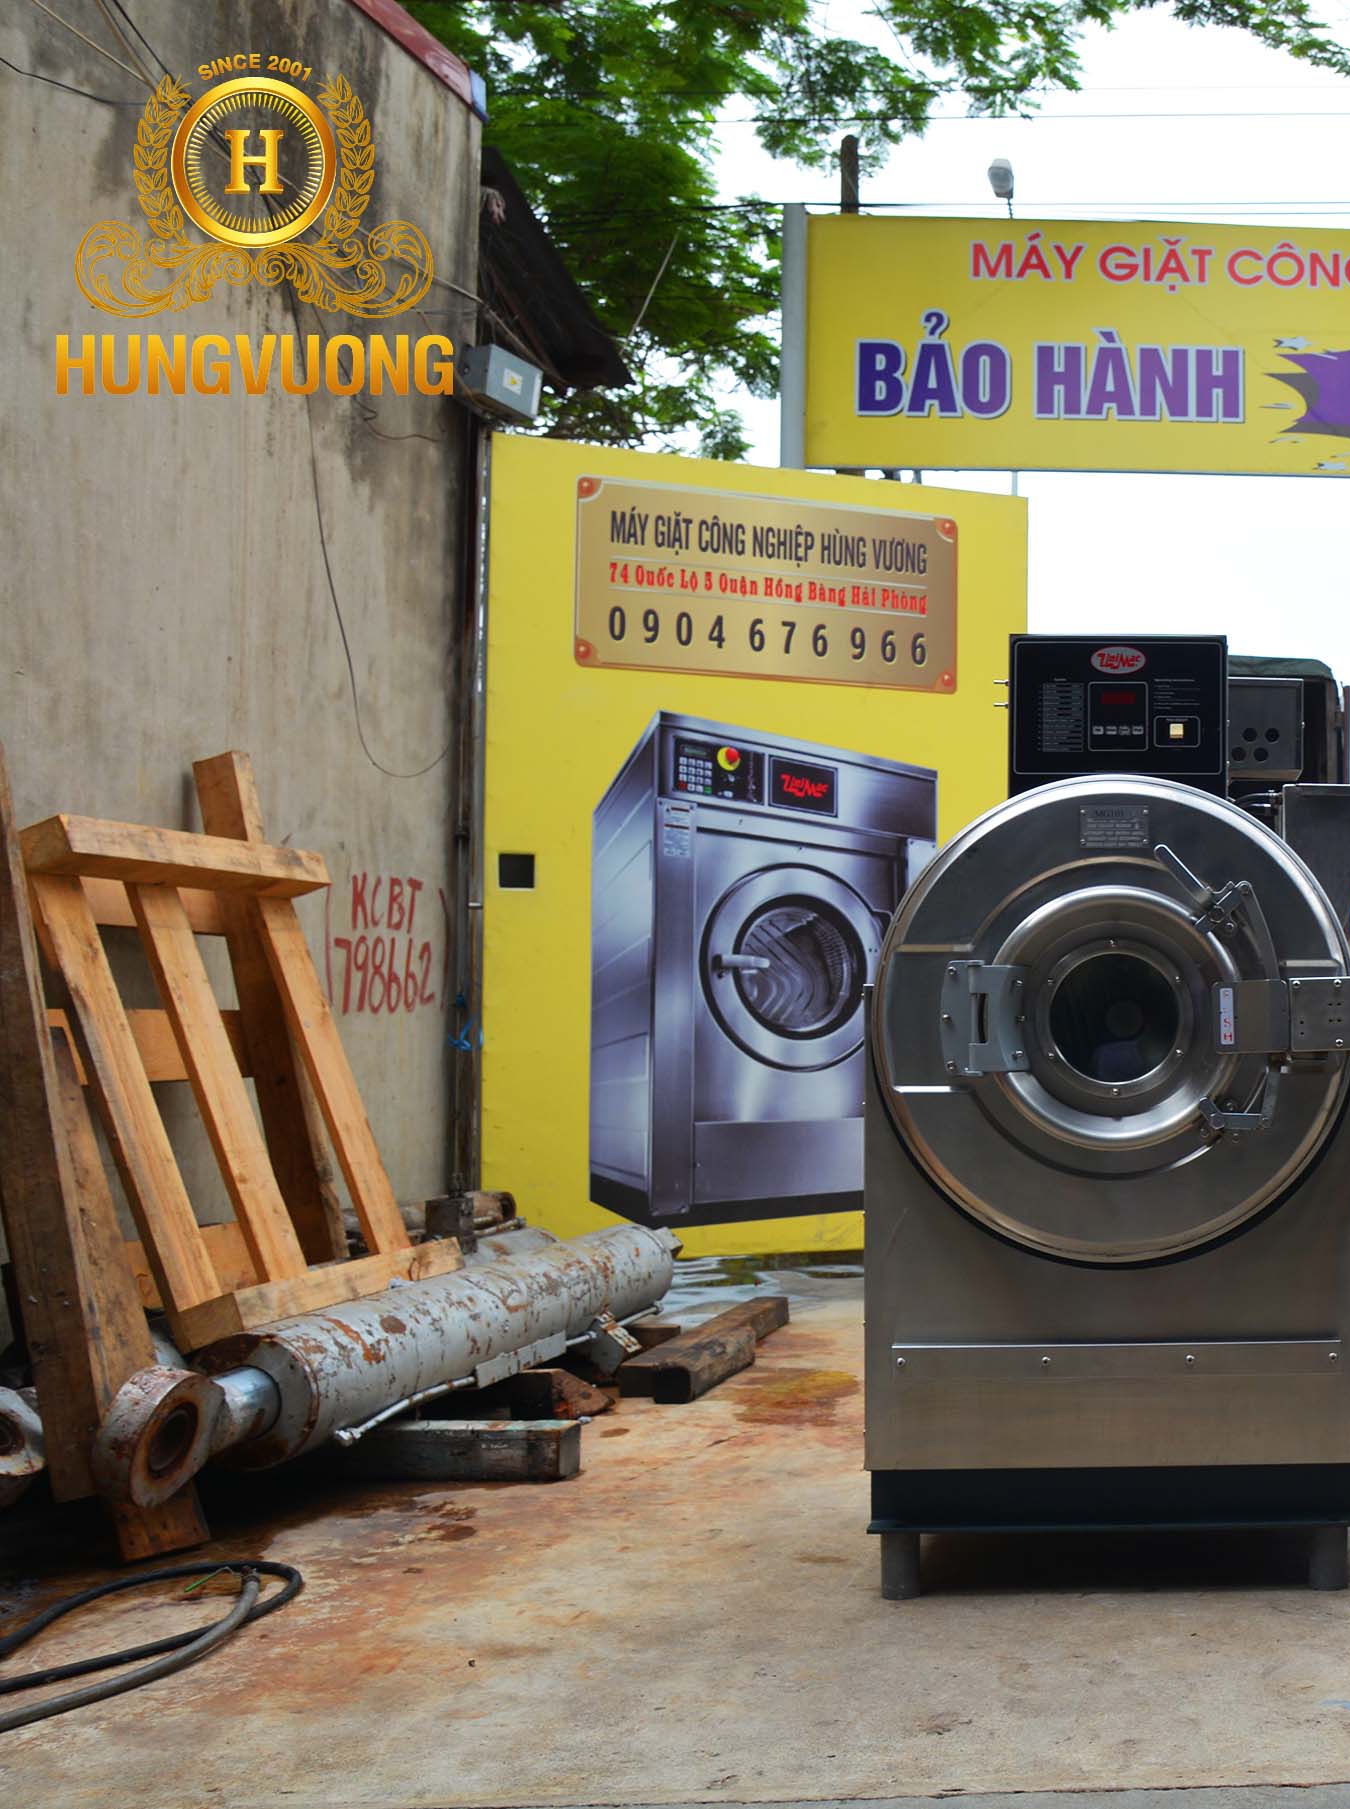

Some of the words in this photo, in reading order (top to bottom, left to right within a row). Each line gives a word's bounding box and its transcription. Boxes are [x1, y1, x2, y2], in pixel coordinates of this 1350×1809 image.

[970, 231, 1084, 281] MÁY
[1098, 236, 1214, 292] GIẶT
[855, 308, 1012, 419] BẢO
[1033, 326, 1245, 423] HÀNH
[610, 506, 649, 546] MÁY
[655, 511, 693, 556] GIẶT
[698, 515, 746, 556] CÔNG
[753, 524, 815, 568] NGHIỆP
[821, 528, 867, 569] HÙNG
[872, 537, 928, 575] VƯƠNG
[609, 562, 629, 585] 74
[635, 564, 675, 588] Quốc
[680, 568, 699, 592] Lộ
[704, 571, 713, 591] 5
[719, 573, 758, 597] Quận
[352, 872, 424, 934] KCBT
[334, 935, 435, 1016] 798662
